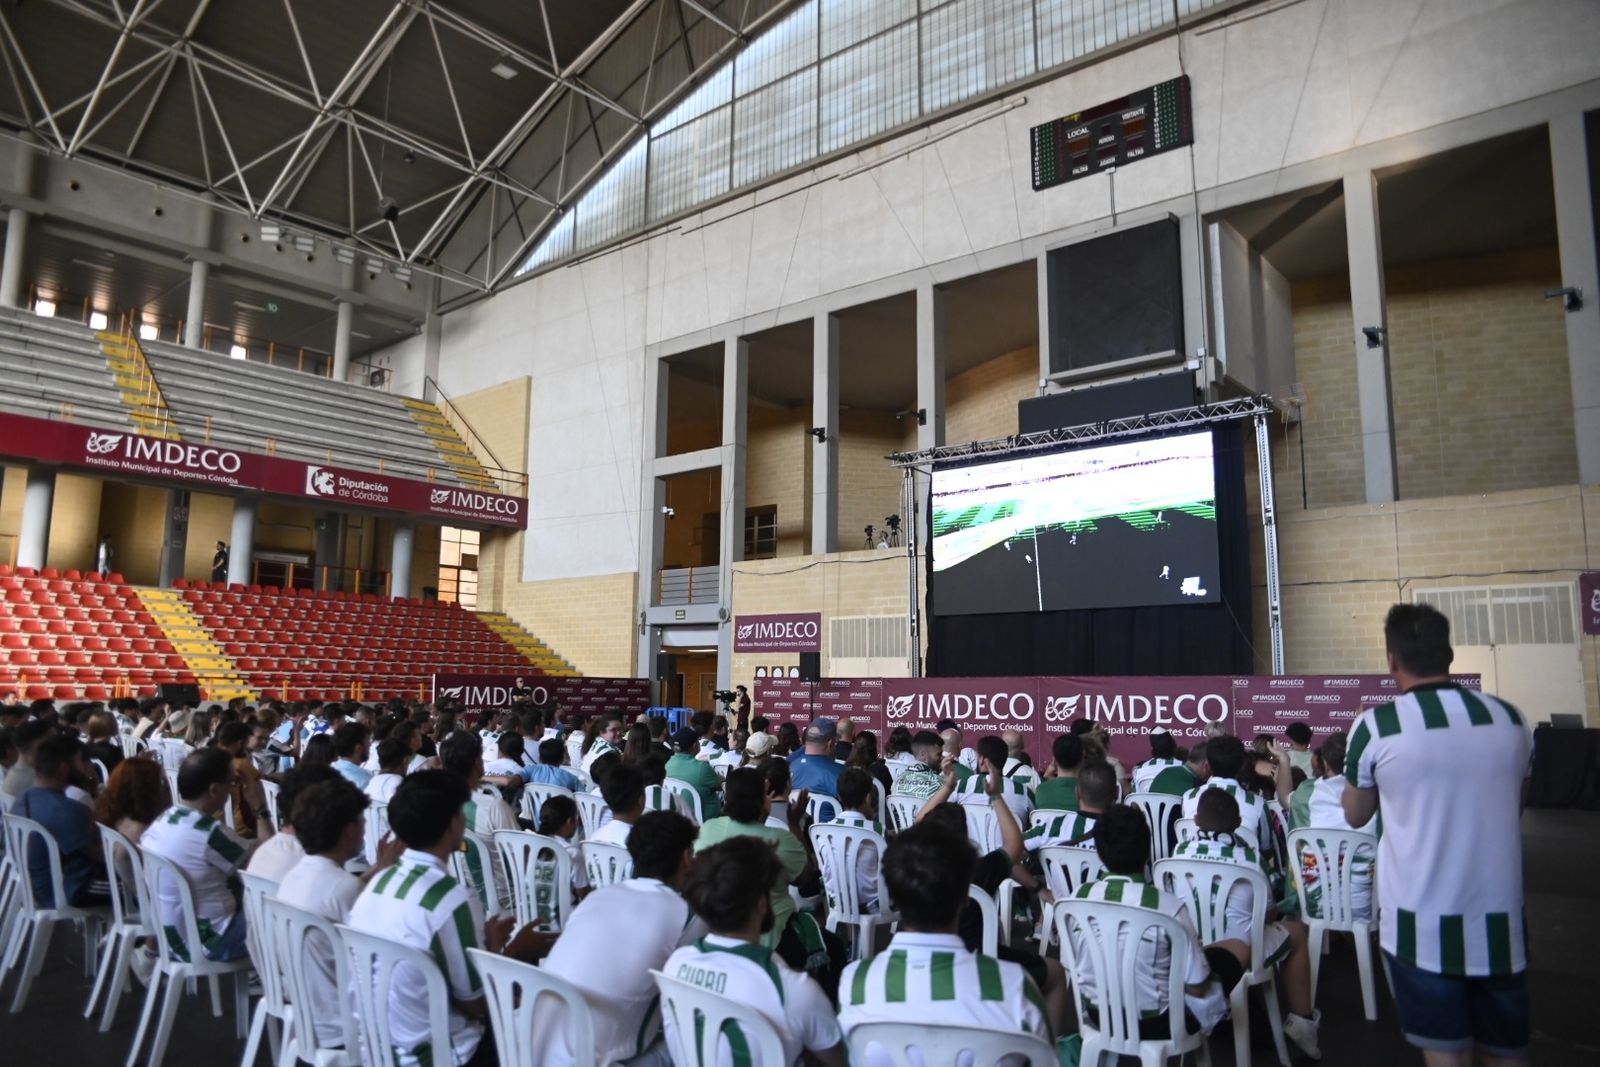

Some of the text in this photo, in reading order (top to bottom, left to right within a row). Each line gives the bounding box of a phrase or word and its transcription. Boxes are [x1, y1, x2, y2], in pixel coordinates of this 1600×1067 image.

[1067, 127, 1089, 139] LOCAL
[125, 436, 241, 473] IMDECO
[86, 456, 120, 468] Instituto
[121, 461, 160, 474] Municipal
[173, 468, 207, 480] Deportes
[208, 473, 238, 484] Córdoba
[339, 477, 388, 492] Diputación
[338, 488, 388, 502] de Córdoba
[452, 491, 518, 515] IMDECO
[755, 621, 817, 638] IMDECO
[918, 692, 1034, 720] IMDECO
[1084, 694, 1228, 724] IMDECO
[964, 722, 997, 734] Deportes
[1000, 723, 1033, 732] Córdoba
[1046, 724, 1071, 733] Institu
[1126, 727, 1139, 735] de
